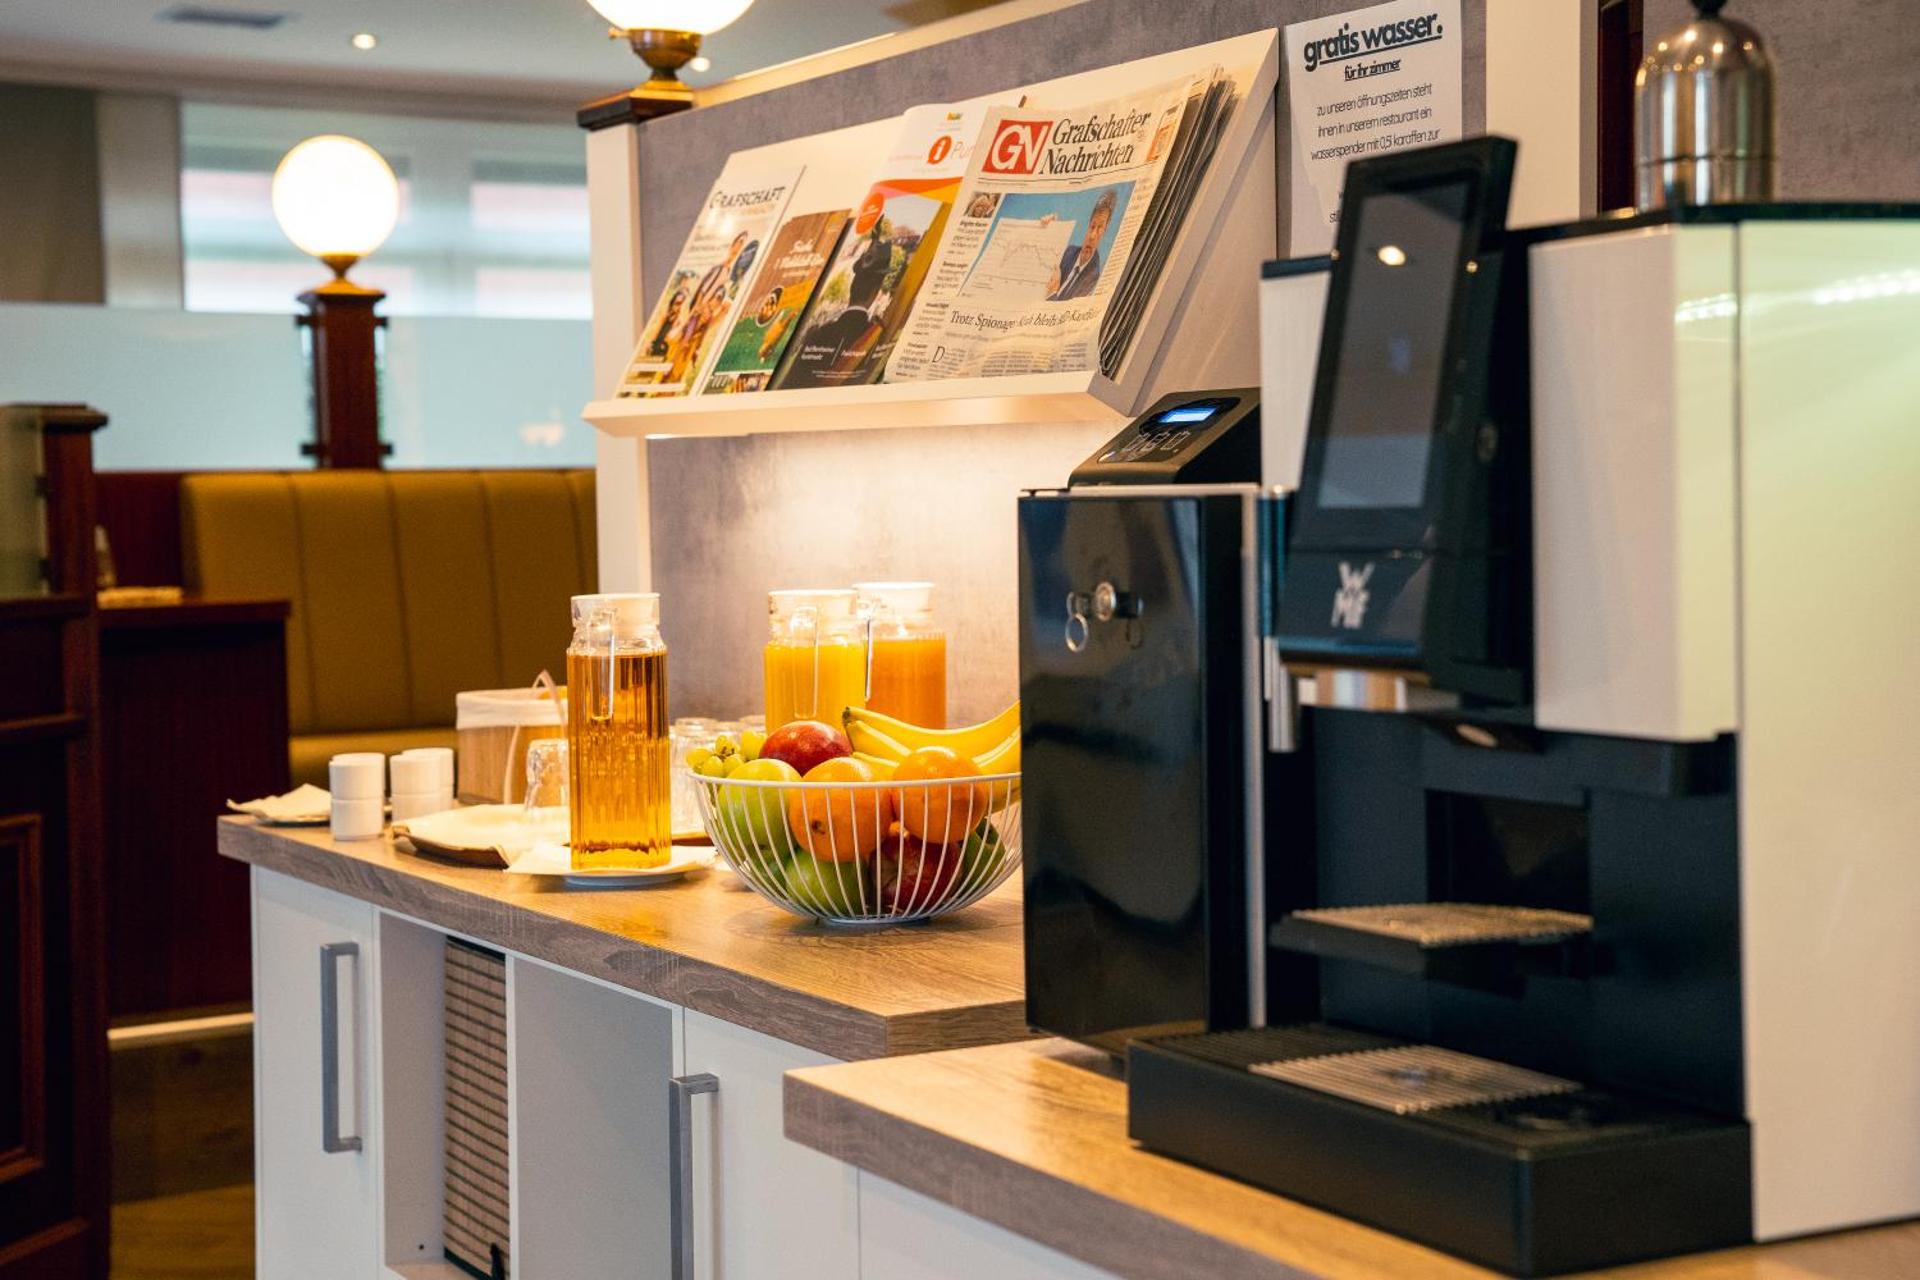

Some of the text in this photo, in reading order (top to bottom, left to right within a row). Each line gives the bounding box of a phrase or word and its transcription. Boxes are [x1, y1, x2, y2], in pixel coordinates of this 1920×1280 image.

[1303, 13, 1443, 72] gratis wasser.
[1344, 59, 1401, 80] für ihr zimmer
[1317, 83, 1432, 117] zu unseren öffnungszeiten steht
[1053, 109, 1151, 145] Grafschafter
[1318, 105, 1432, 138] ihnen in unserem restaurant ein
[1039, 143, 1134, 174] Nachrichten
[1310, 139, 1366, 161] wasserspender
[1366, 137, 1380, 152] mit
[1393, 129, 1427, 147] karaffen
[1427, 128, 1441, 141] zur
[950, 310, 974, 326] Trotz
